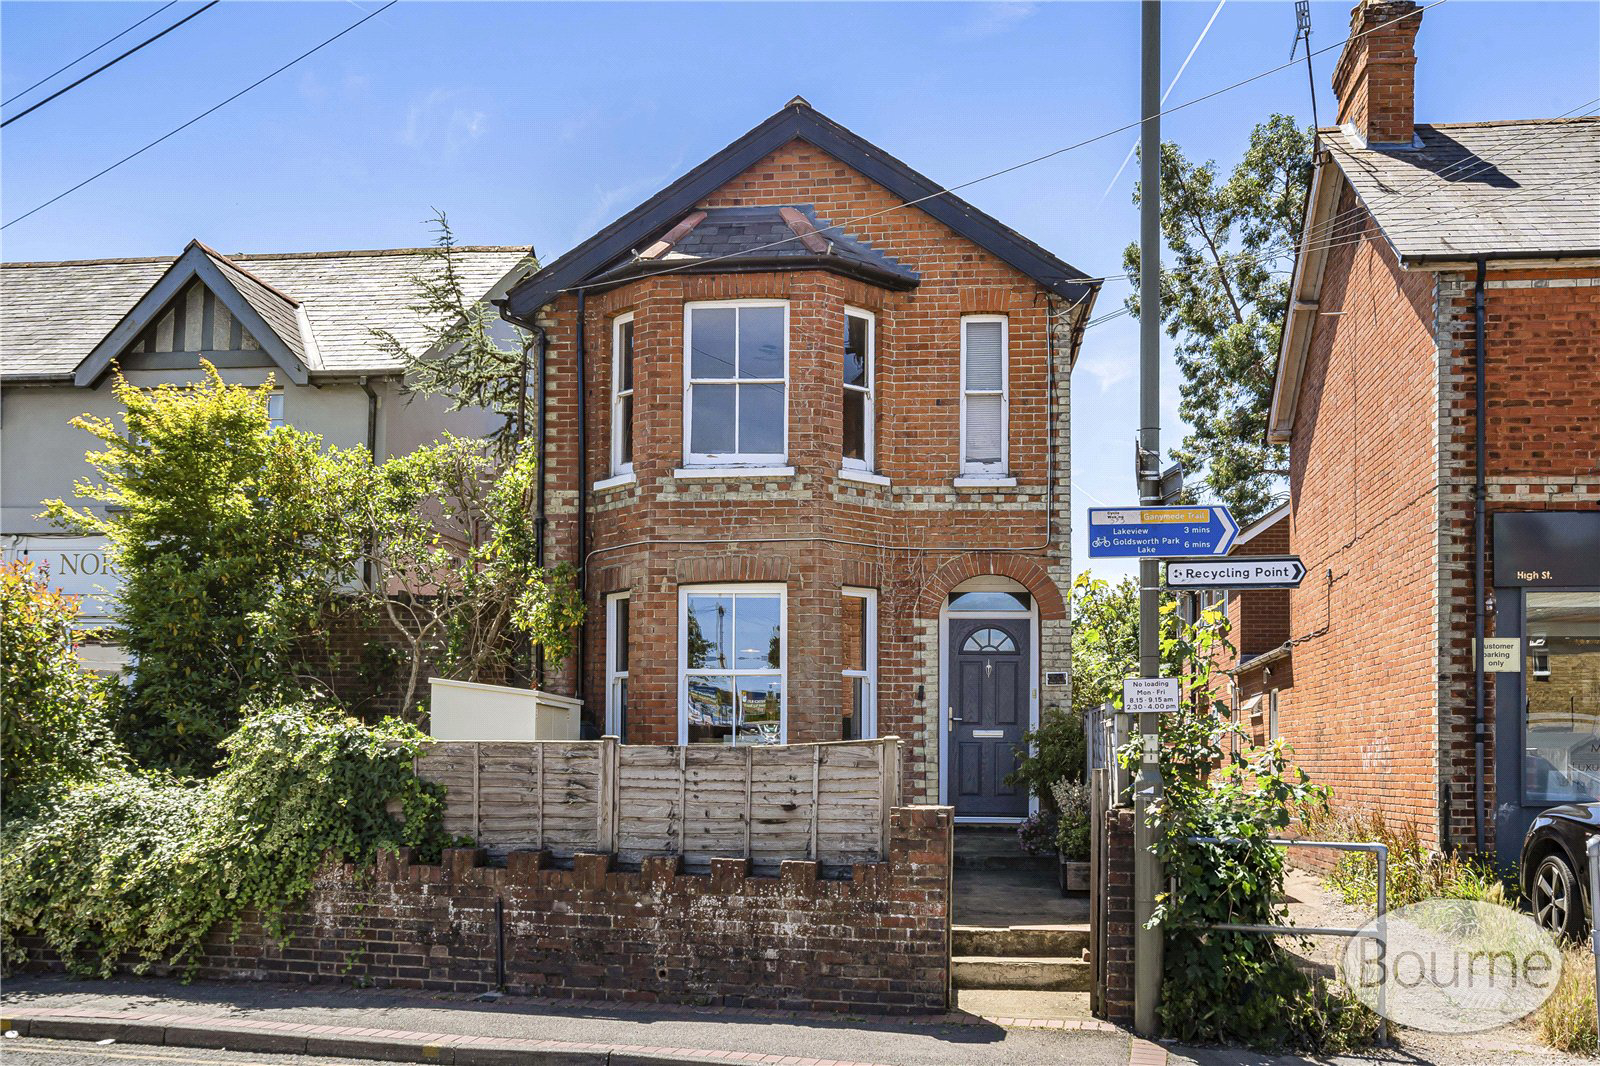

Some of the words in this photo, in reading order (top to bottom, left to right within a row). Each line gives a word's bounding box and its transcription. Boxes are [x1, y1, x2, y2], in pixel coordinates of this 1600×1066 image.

[1143, 513, 1184, 521] Ganymede
[1184, 526, 1190, 534] 3
[1113, 537, 1159, 545] Goldsworth
[1162, 537, 1180, 545] Park
[1186, 567, 1250, 580] Recycling
[1255, 566, 1289, 578] Point
[1517, 571, 1539, 581] High
[1541, 570, 1553, 580] St.
[1488, 660, 1504, 668] only
